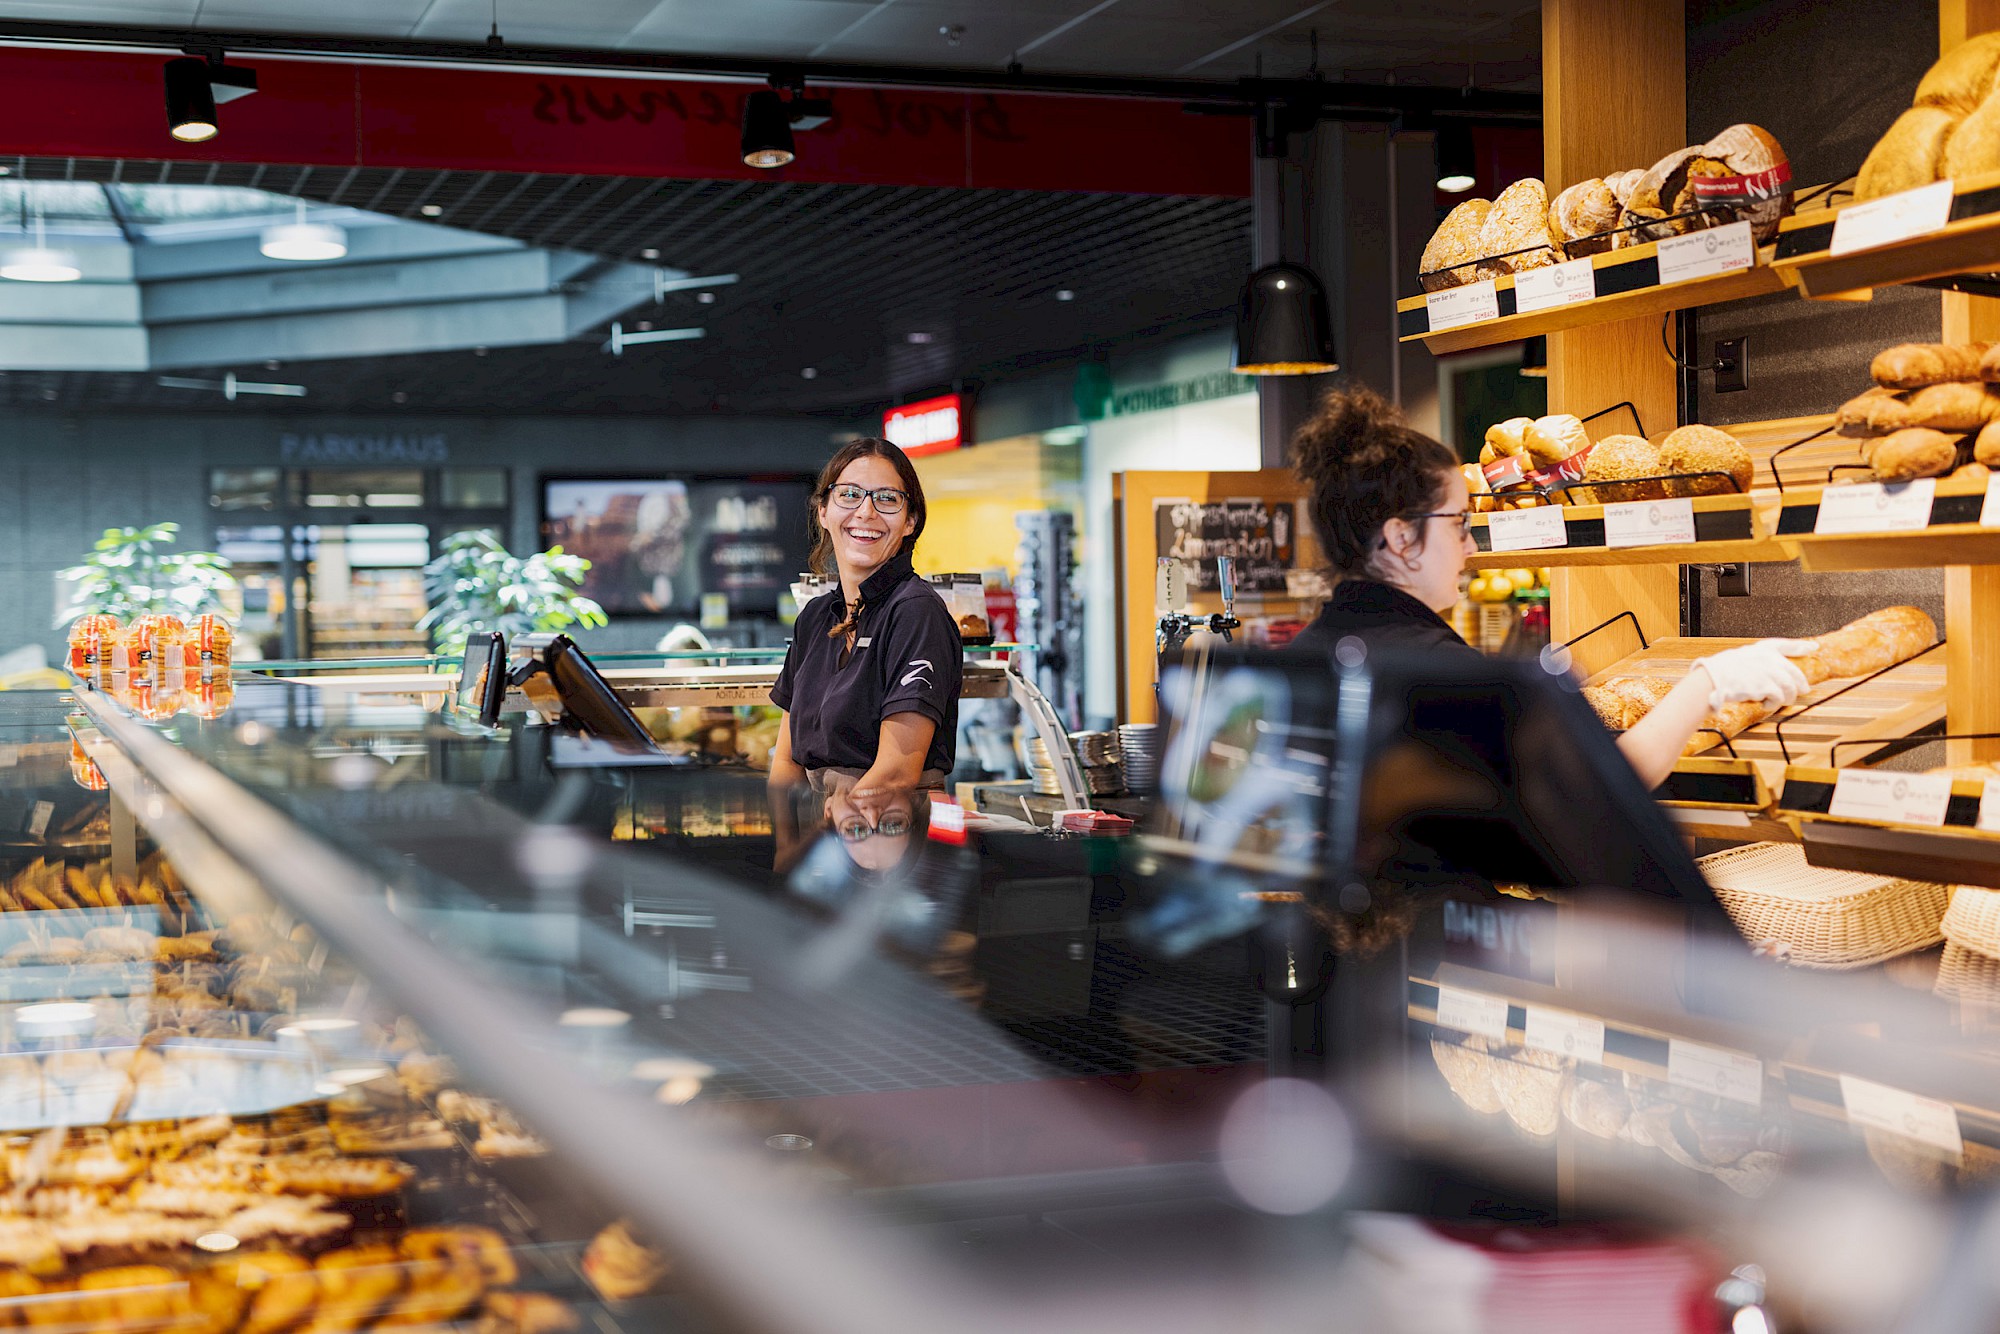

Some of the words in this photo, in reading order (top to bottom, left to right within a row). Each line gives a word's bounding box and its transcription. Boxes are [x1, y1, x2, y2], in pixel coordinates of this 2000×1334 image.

[1721, 257, 1749, 270] ZUMBACH
[1568, 290, 1592, 302] ZUMBACH
[1474, 310, 1496, 321] ZUMBACH
